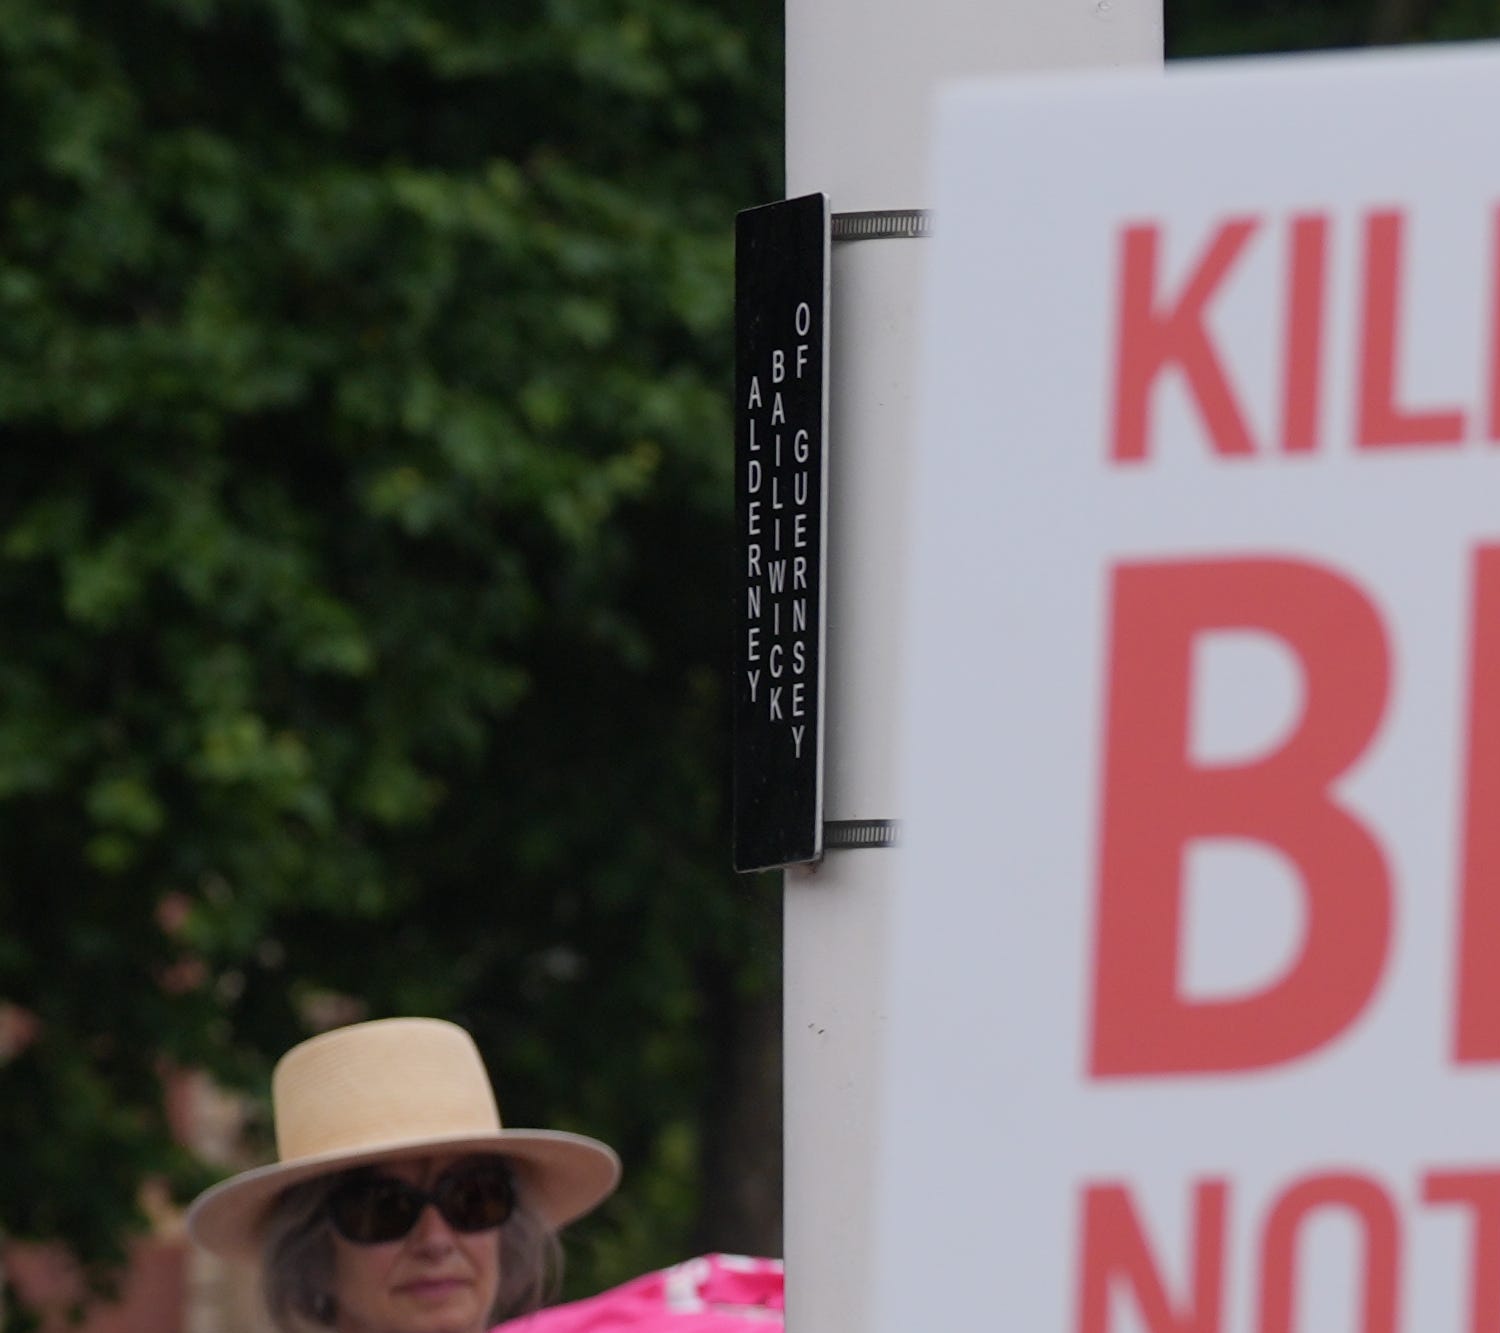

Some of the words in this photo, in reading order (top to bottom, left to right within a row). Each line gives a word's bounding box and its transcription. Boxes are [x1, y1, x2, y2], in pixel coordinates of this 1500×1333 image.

[795, 302, 810, 378] OF
[748, 375, 762, 703] ALDERNEY
[768, 349, 786, 721] BAILIWICK
[791, 430, 809, 758] GUERNSEY
